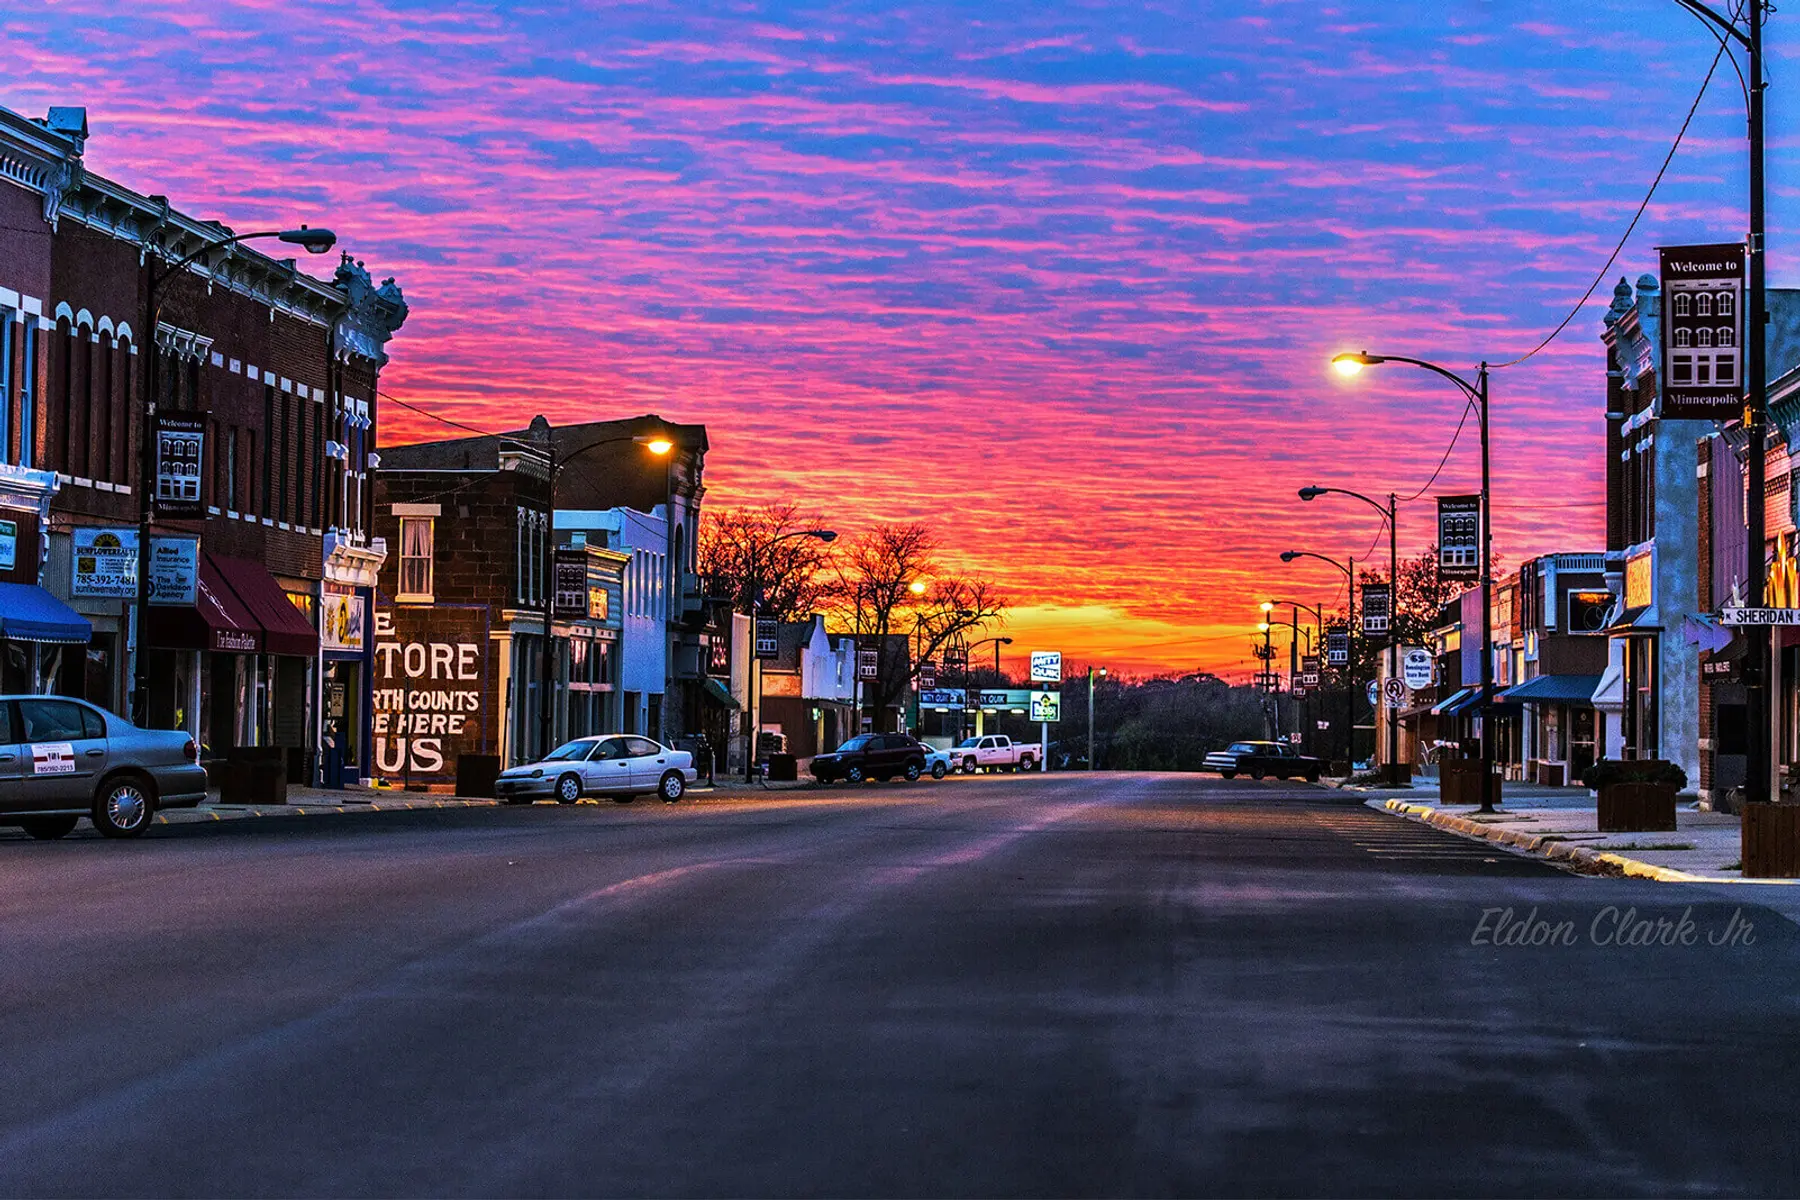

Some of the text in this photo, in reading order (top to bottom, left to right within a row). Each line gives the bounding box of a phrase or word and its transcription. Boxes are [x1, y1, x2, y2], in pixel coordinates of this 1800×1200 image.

[1670, 260, 1738, 272] Welcome to
[1669, 393, 1739, 406] Minneapolis
[159, 418, 202, 429] Welcome to
[156, 547, 179, 555] Allied
[156, 556, 190, 564] Insurance
[1441, 568, 1477, 576] Minneapolis
[76, 574, 135, 586] 785-392-7481
[156, 575, 171, 583] The
[156, 583, 191, 591] Davidson
[156, 591, 185, 600] Agency
[1736, 610, 1793, 624] SHERIDAN
[374, 642, 479, 680] TORE
[372, 688, 479, 712] RTH COUNTS
[396, 713, 466, 735] HERE
[376, 737, 443, 773] US
